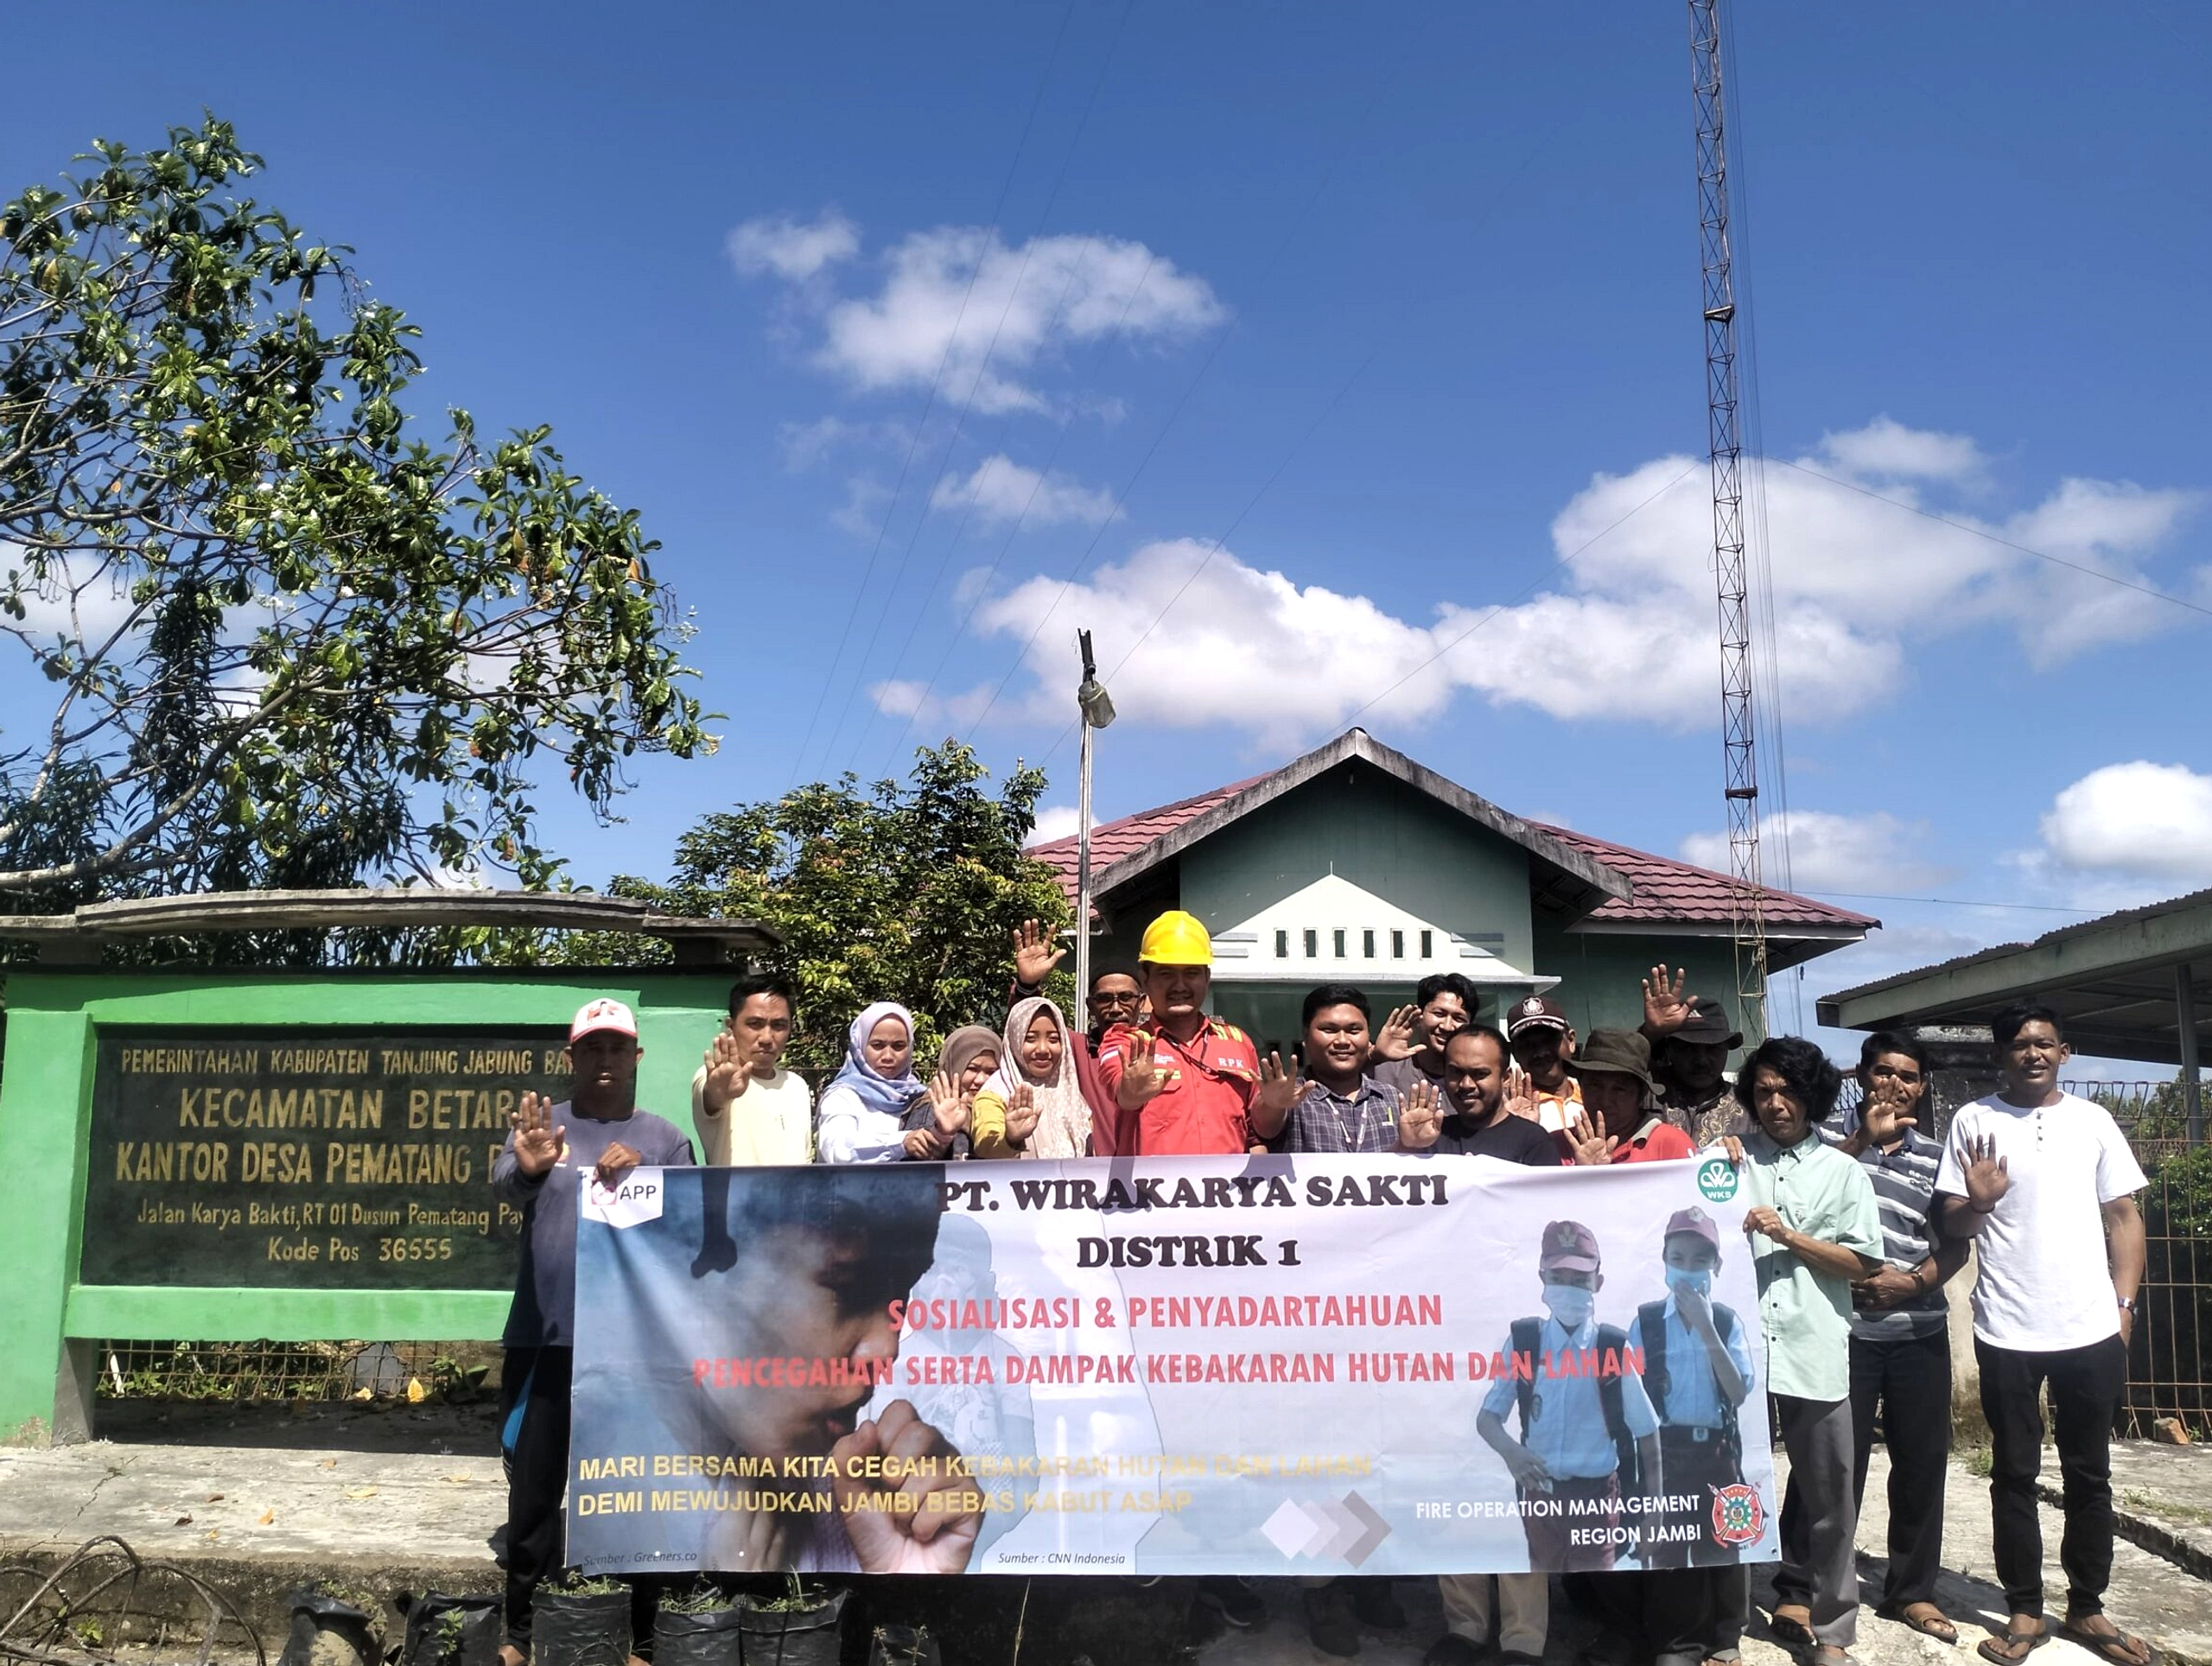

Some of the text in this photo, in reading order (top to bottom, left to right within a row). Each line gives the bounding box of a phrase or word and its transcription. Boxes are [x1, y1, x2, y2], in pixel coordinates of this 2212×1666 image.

[122, 1049, 257, 1073] PEMERINTAHAN
[271, 1049, 368, 1074] KABUPATEN
[383, 1050, 458, 1074] TANJUNG
[463, 1050, 532, 1075] JABUNG
[1217, 1057, 1244, 1068] RPK
[180, 1088, 531, 1129] KECAMATAN BETAR
[117, 1141, 228, 1182] KANTOR
[242, 1141, 313, 1183] DESA
[325, 1142, 470, 1184] PEMATANG
[620, 1185, 657, 1200] APP
[937, 1173, 1447, 1212] PT. WIRAKARYA SAKTI
[137, 1200, 185, 1224] Jalan
[192, 1201, 241, 1231] Karya
[352, 1205, 399, 1225] Dusun
[408, 1204, 489, 1234] Pematang
[267, 1237, 453, 1262] Kode Pos 36555
[1077, 1236, 1301, 1269] DISTRIK 1
[887, 1295, 1442, 1331] SOSIALISASI & PENYADARTAHUAN
[693, 1346, 1646, 1388] PENCEGAHAN SERTA DAMPAK KEBAKARAN HUTAN DAN LAHAN
[580, 1453, 1372, 1480] MARI BERSAMA KITA CEGAH KEBAKARAN HUTAN DAN LAHAN
[578, 1491, 1193, 1516] DEMI MEWUJUDKAN JAMBI BEBAS KABUT ASAP
[1416, 1494, 1700, 1519] FIRE OPERATION MANAGEMENT
[1571, 1523, 1702, 1546] REGION JAMBI
[584, 1553, 624, 1566] Sumber
[634, 1552, 697, 1563] Greeners.co
[999, 1553, 1039, 1563] Sumber
[1048, 1553, 1071, 1564] CNN
[1074, 1553, 1125, 1564] Indonesia
